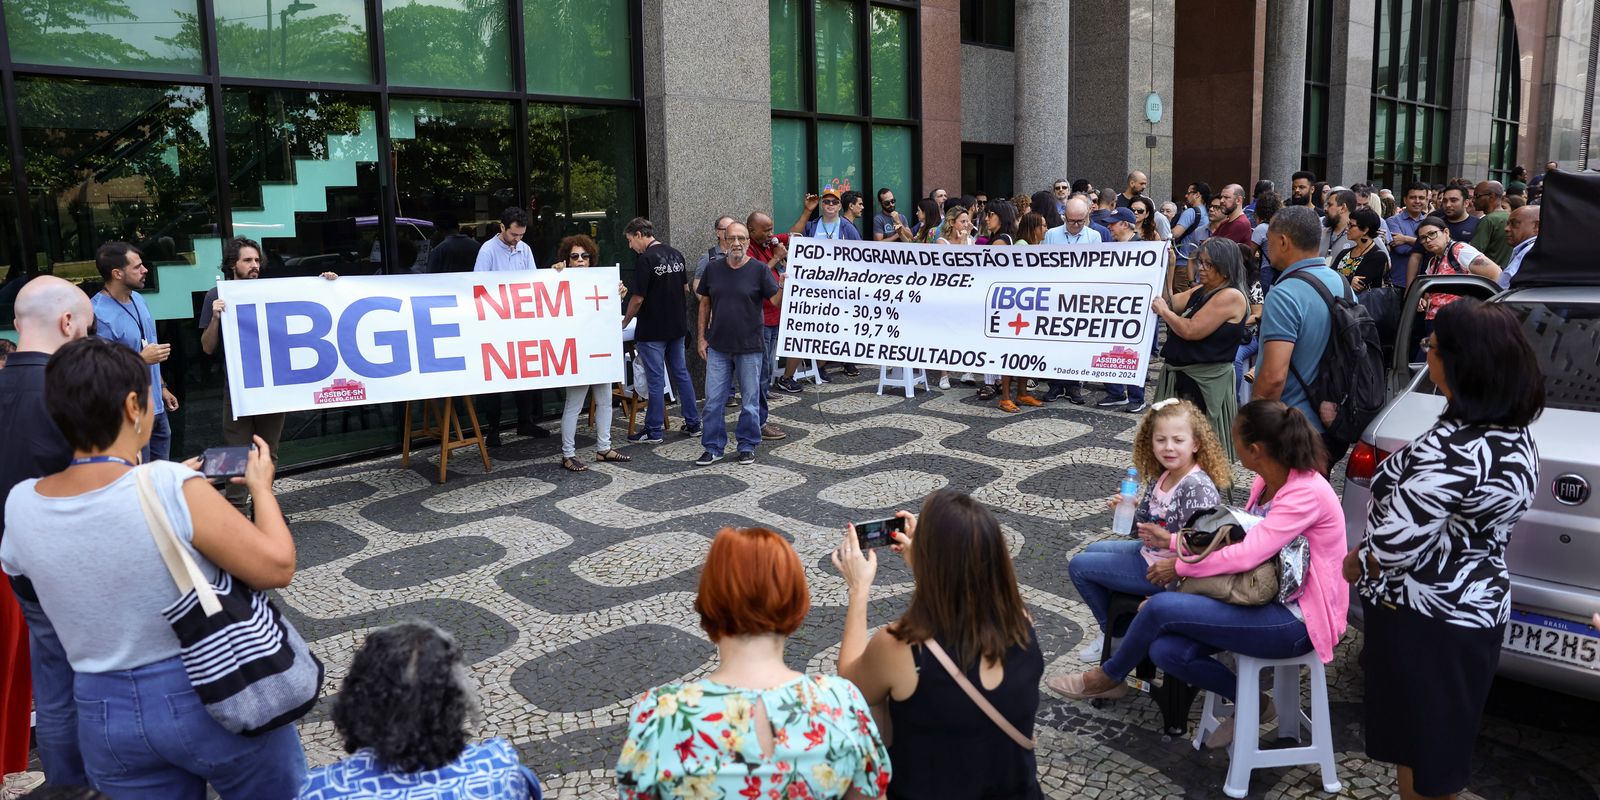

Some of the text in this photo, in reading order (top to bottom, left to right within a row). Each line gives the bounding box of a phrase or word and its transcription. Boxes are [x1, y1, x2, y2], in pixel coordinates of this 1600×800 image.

[794, 244, 825, 259] PGD
[833, 246, 918, 266] PROGRAMA
[920, 251, 941, 266] DE
[942, 249, 1009, 268] GESTÃO
[1012, 252, 1023, 267] E
[1026, 250, 1157, 268] DESEMPENHO
[793, 265, 974, 288] Trabalhadores do IBGE:
[473, 280, 574, 321] NEM
[790, 284, 861, 300] Presencial
[873, 288, 904, 304] 49,4
[908, 290, 922, 303] %
[991, 286, 1144, 315] IBGE MERECE
[788, 301, 840, 317] Híbrido
[852, 305, 882, 321] 30,9
[886, 307, 899, 320] %
[786, 318, 840, 333] Remoto
[853, 322, 883, 339] 19,7
[887, 325, 900, 338] %
[990, 311, 1000, 333] É
[1034, 315, 1142, 339] RESPEITO
[235, 294, 466, 389] IBGE
[480, 337, 579, 382] NEM
[783, 337, 851, 356] ENTREGA
[854, 342, 875, 359] DE
[878, 344, 987, 367] RESULTADOS
[1000, 353, 1047, 372] 100%
[1096, 357, 1137, 365] ASSIBGE-SN
[1080, 368, 1090, 376] de
[1091, 370, 1117, 378] agosto
[319, 389, 363, 399] ASSIBGE-SN
[1560, 483, 1581, 498] FIAT
[1543, 620, 1568, 630] BRASIL
[1508, 623, 1600, 663] PM2H5
